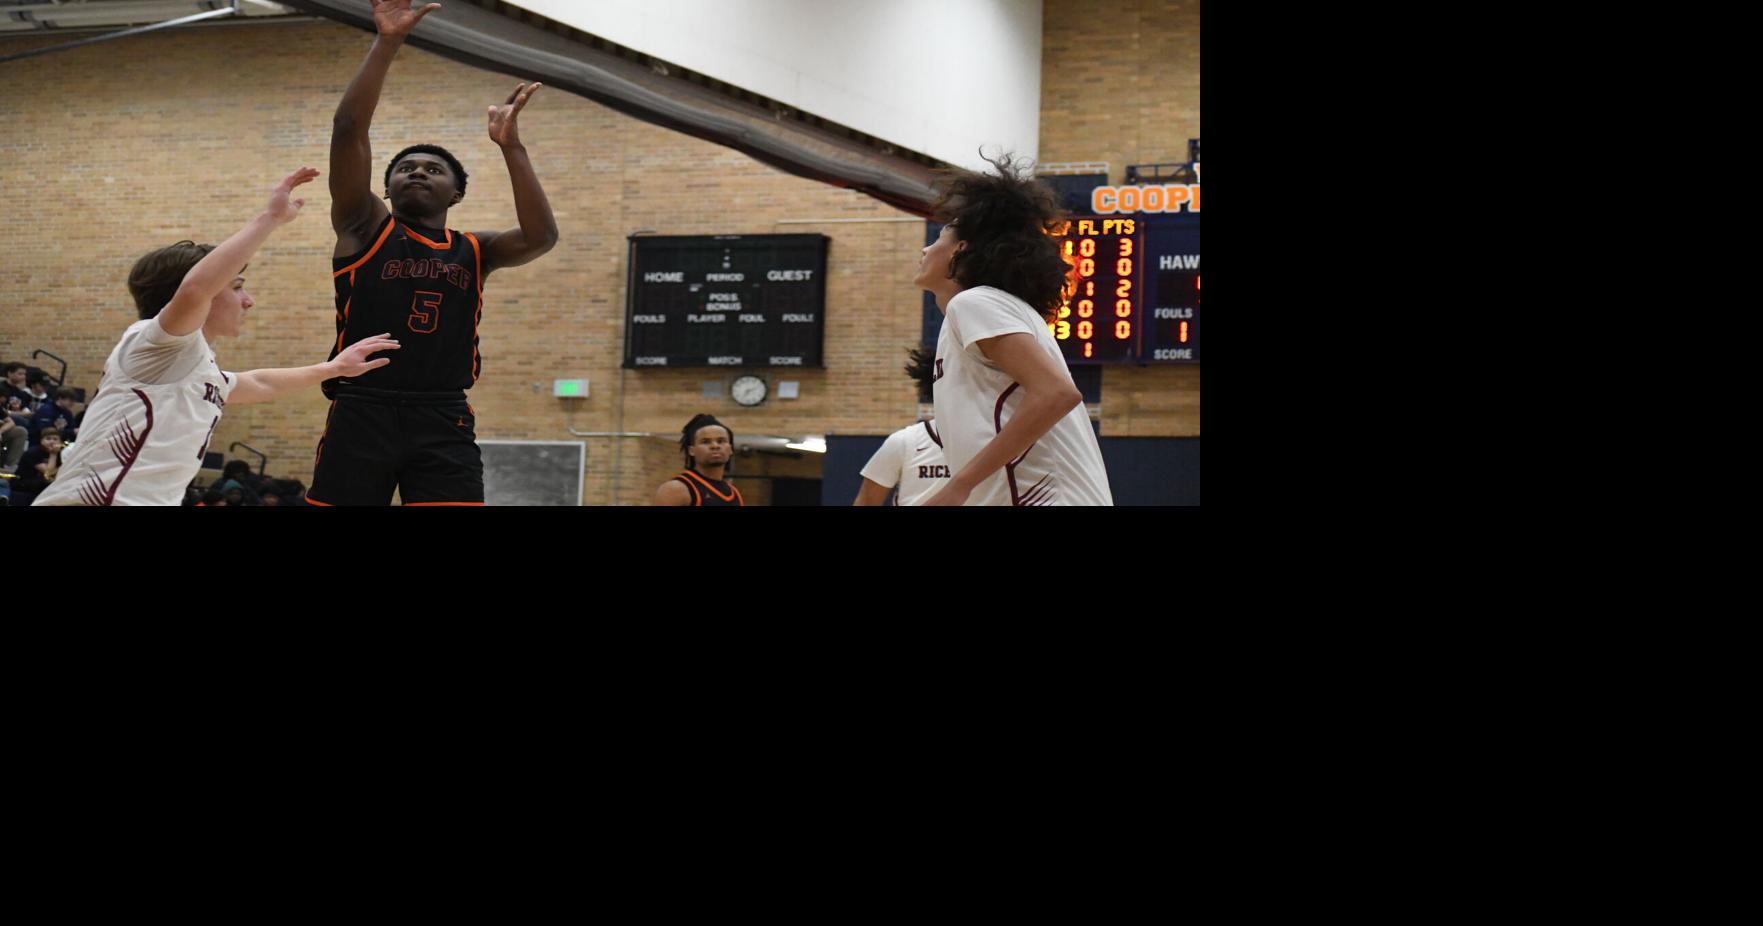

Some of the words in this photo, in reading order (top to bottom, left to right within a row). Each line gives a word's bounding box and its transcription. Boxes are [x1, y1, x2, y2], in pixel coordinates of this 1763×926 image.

[1078, 219, 1099, 236] FL
[1103, 218, 1136, 236] PTS
[1079, 238, 1096, 257] 0
[1119, 237, 1133, 257] 3
[1079, 258, 1095, 277] 0
[1116, 257, 1132, 277] 0
[644, 272, 684, 283] HOME
[706, 272, 744, 282] PERIOD
[767, 270, 813, 281] GUEST
[1115, 279, 1132, 298] 2
[407, 290, 443, 334] 5
[706, 302, 742, 311] BONUS
[1078, 299, 1094, 319] 0
[1116, 299, 1132, 319] 0
[633, 314, 666, 323] FOULS
[687, 313, 725, 323] PLAYER
[739, 313, 766, 323] FOUL
[1154, 307, 1193, 319] FOULS
[1077, 320, 1093, 340] 0
[1115, 320, 1131, 340] 0
[1154, 348, 1192, 360] SCORE
[635, 356, 667, 365] SCORE
[708, 356, 743, 365] MATCH
[769, 356, 803, 365] SCORE
